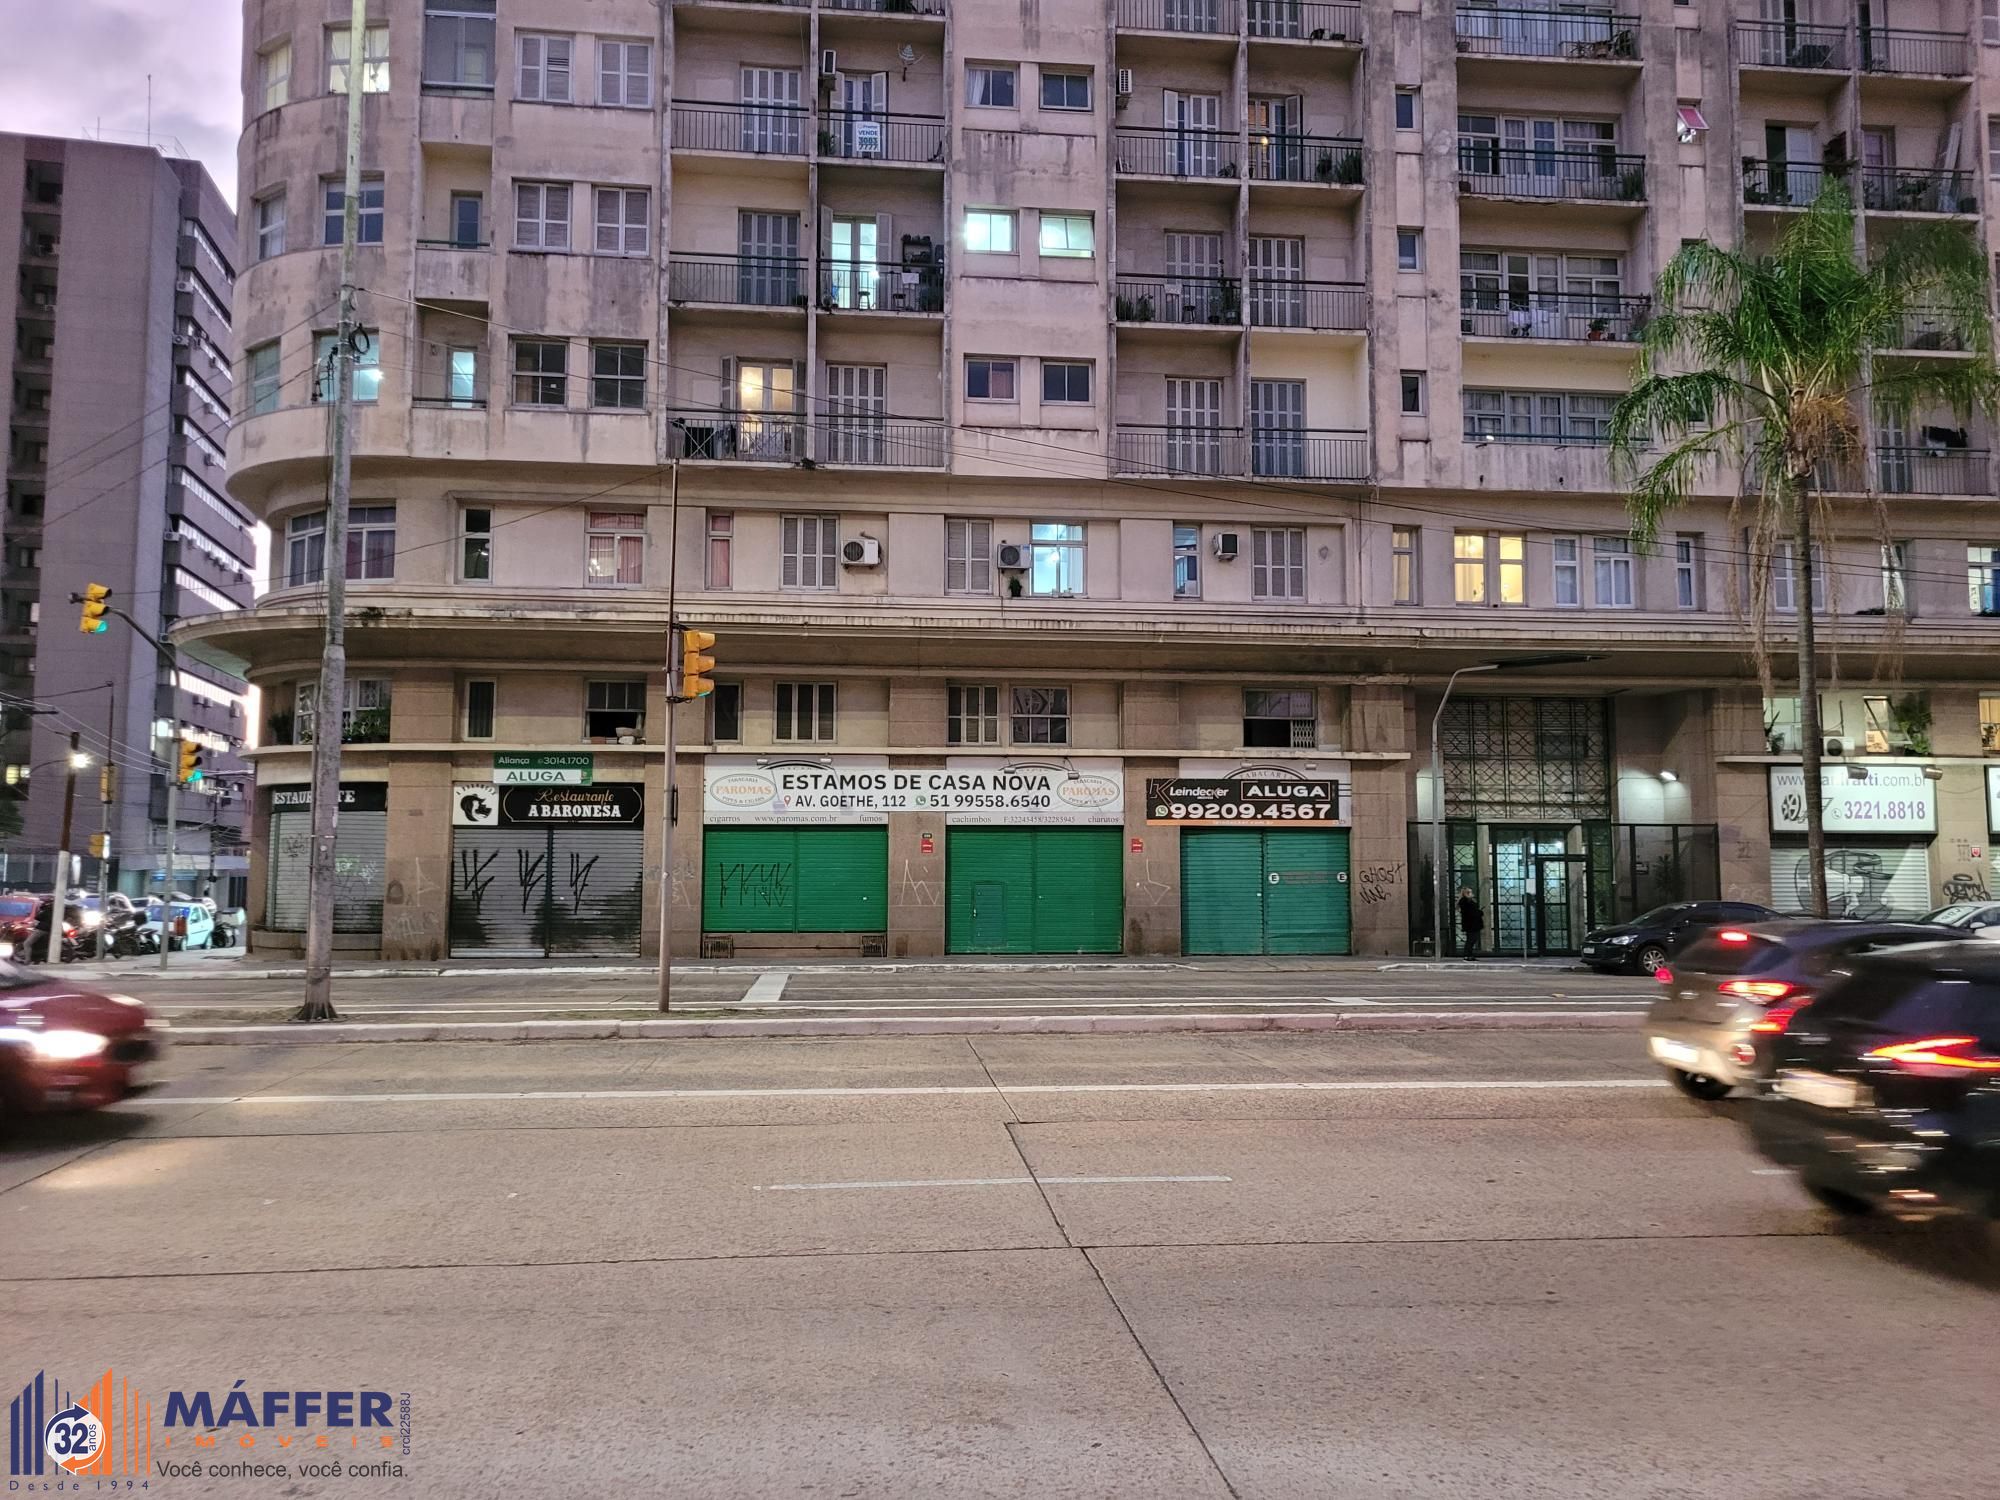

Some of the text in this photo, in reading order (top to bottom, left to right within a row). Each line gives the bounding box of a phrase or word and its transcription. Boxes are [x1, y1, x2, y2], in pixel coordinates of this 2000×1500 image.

[498, 757, 590, 765] Aliança 3014.1700
[505, 771, 566, 782] ALUGA
[782, 774, 1051, 791] ESTAMOS DE CASA NOVA
[715, 785, 772, 795] PAROMAS
[1062, 786, 1116, 796] PAROMAS
[1246, 785, 1326, 797] ALUGA
[535, 789, 615, 805] Restaurante
[795, 794, 1051, 809] AV. GOETHE, 112 51 99558.6540
[528, 804, 622, 818] A BARONESA
[1170, 803, 1331, 819] 99209.4567
[1844, 800, 1926, 820] 3221.8818
[709, 815, 741, 824] cigarros
[754, 814, 838, 824] www.paromas.com.br
[859, 814, 883, 823] fumos
[951, 815, 992, 823] cachimbos
[1087, 815, 1119, 823] charutos
